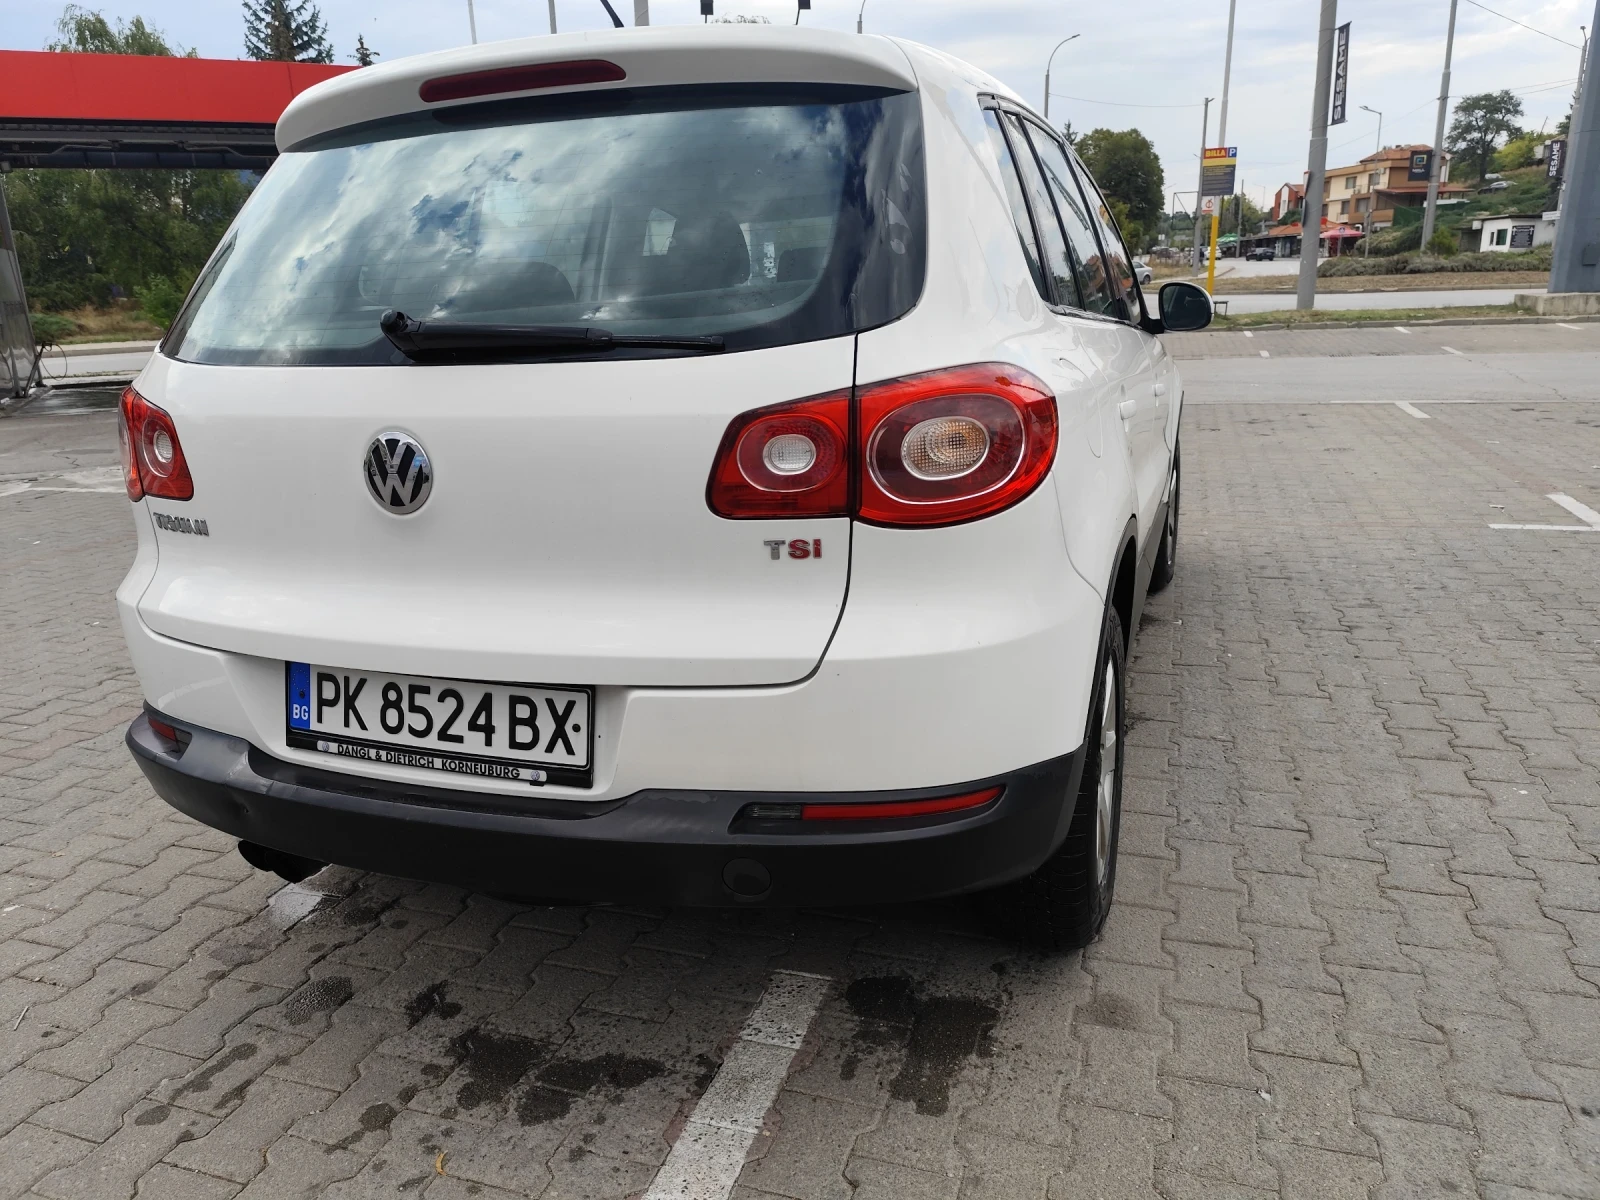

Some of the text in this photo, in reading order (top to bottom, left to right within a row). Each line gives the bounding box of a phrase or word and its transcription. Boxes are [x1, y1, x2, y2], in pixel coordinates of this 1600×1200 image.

[1333, 29, 1347, 121] SESAME
[1205, 149, 1226, 158] BILLA
[1229, 148, 1236, 157] P
[1549, 141, 1560, 177] SESAME
[763, 538, 822, 560] TSI
[292, 703, 309, 721] BG
[316, 671, 577, 756] PK 8524 BX
[337, 743, 521, 779] DANGL & DIETRICH KORNEUBURG
